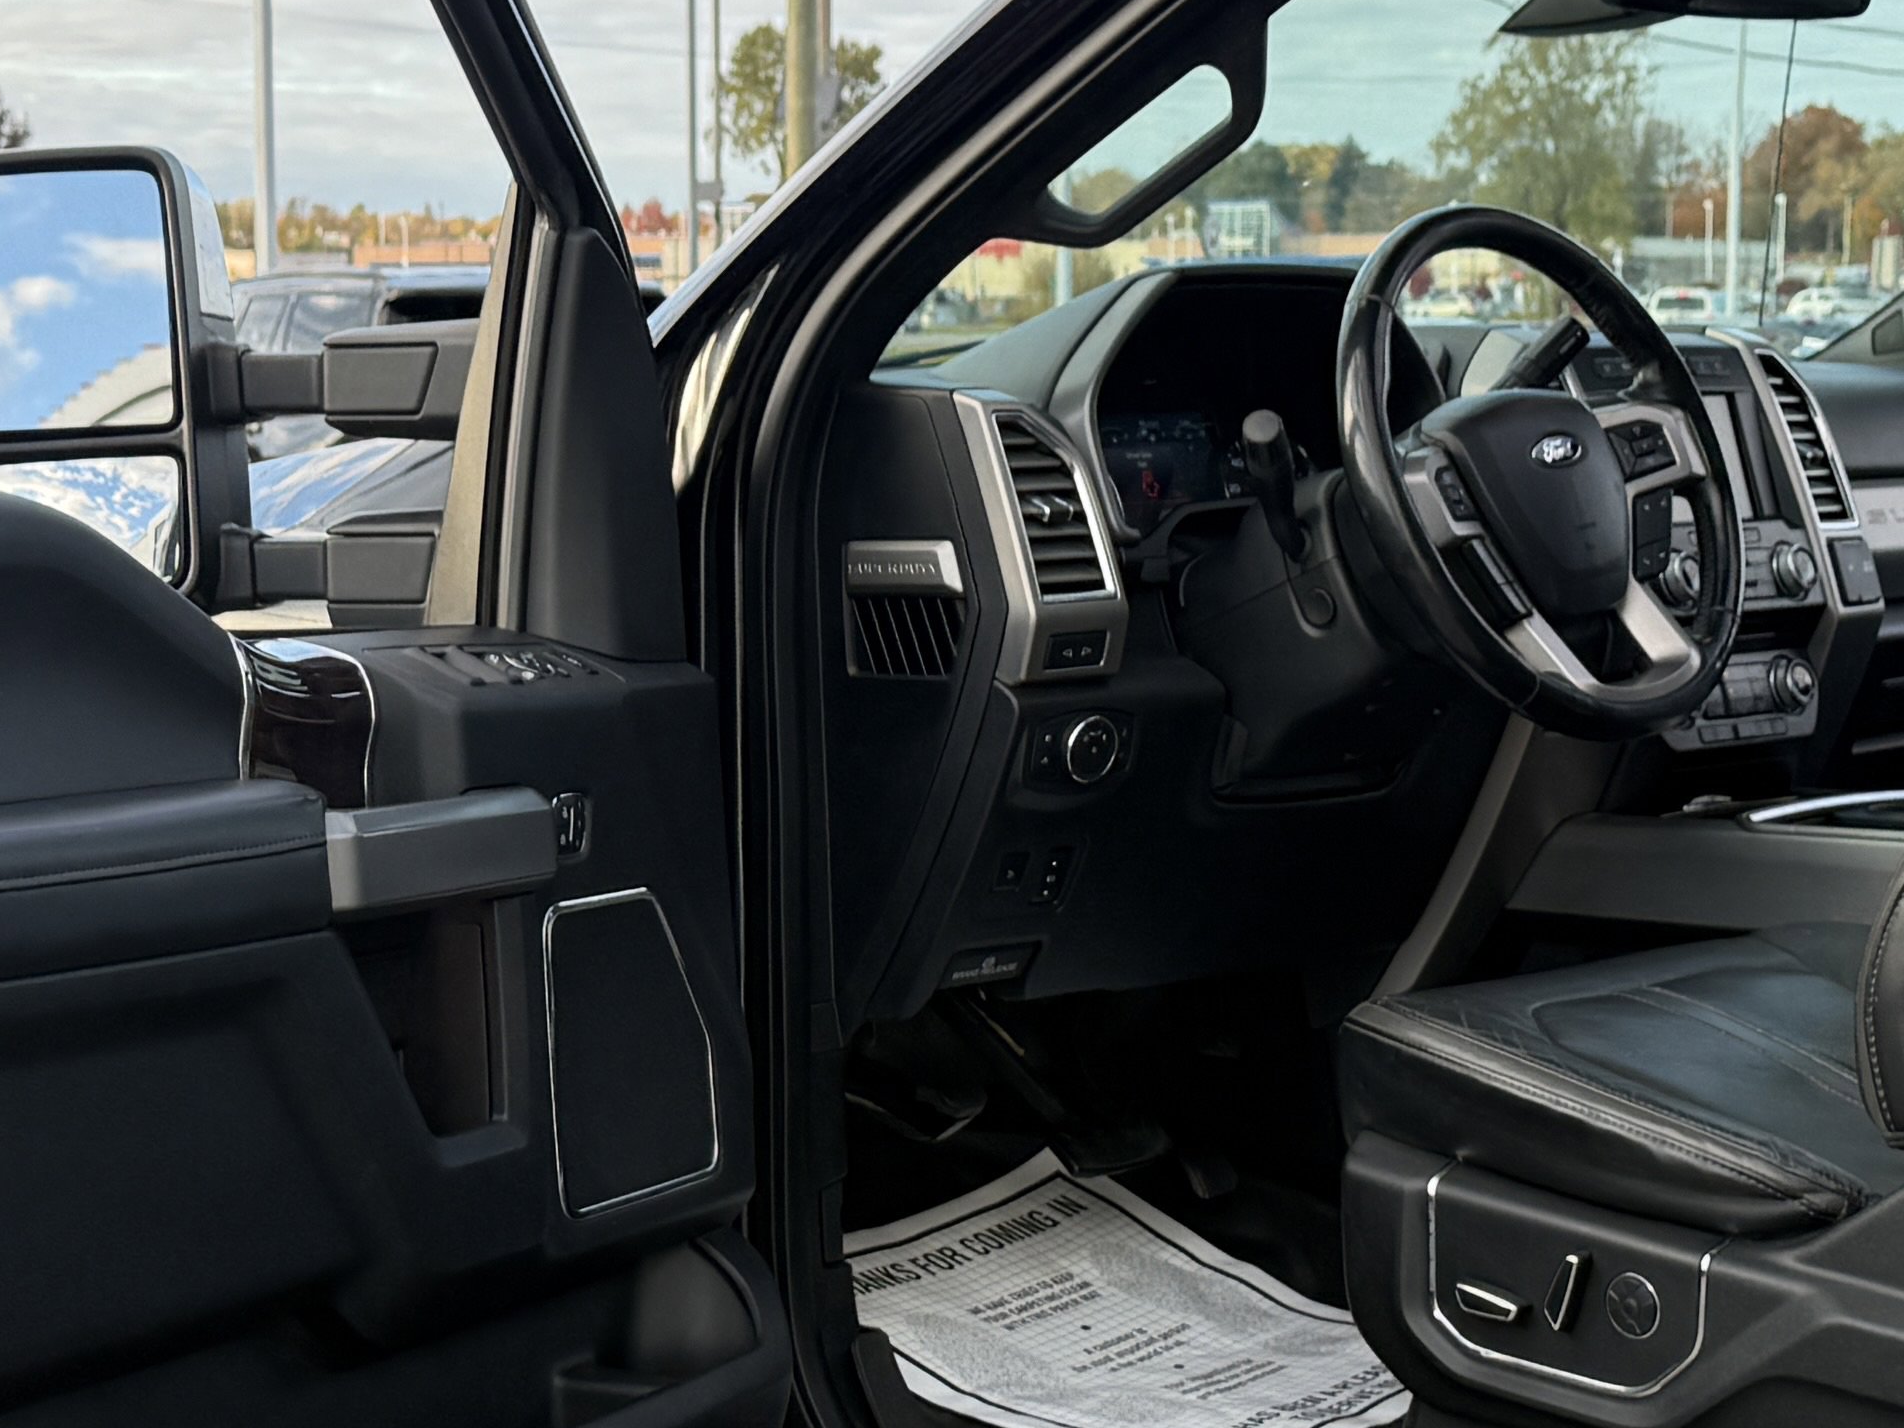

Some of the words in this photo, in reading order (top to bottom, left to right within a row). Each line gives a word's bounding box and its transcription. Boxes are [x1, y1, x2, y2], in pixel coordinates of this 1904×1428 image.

[908, 1246, 973, 1276] FOR
[959, 1209, 1062, 1256] COMING
[1046, 1193, 1089, 1218] IN
